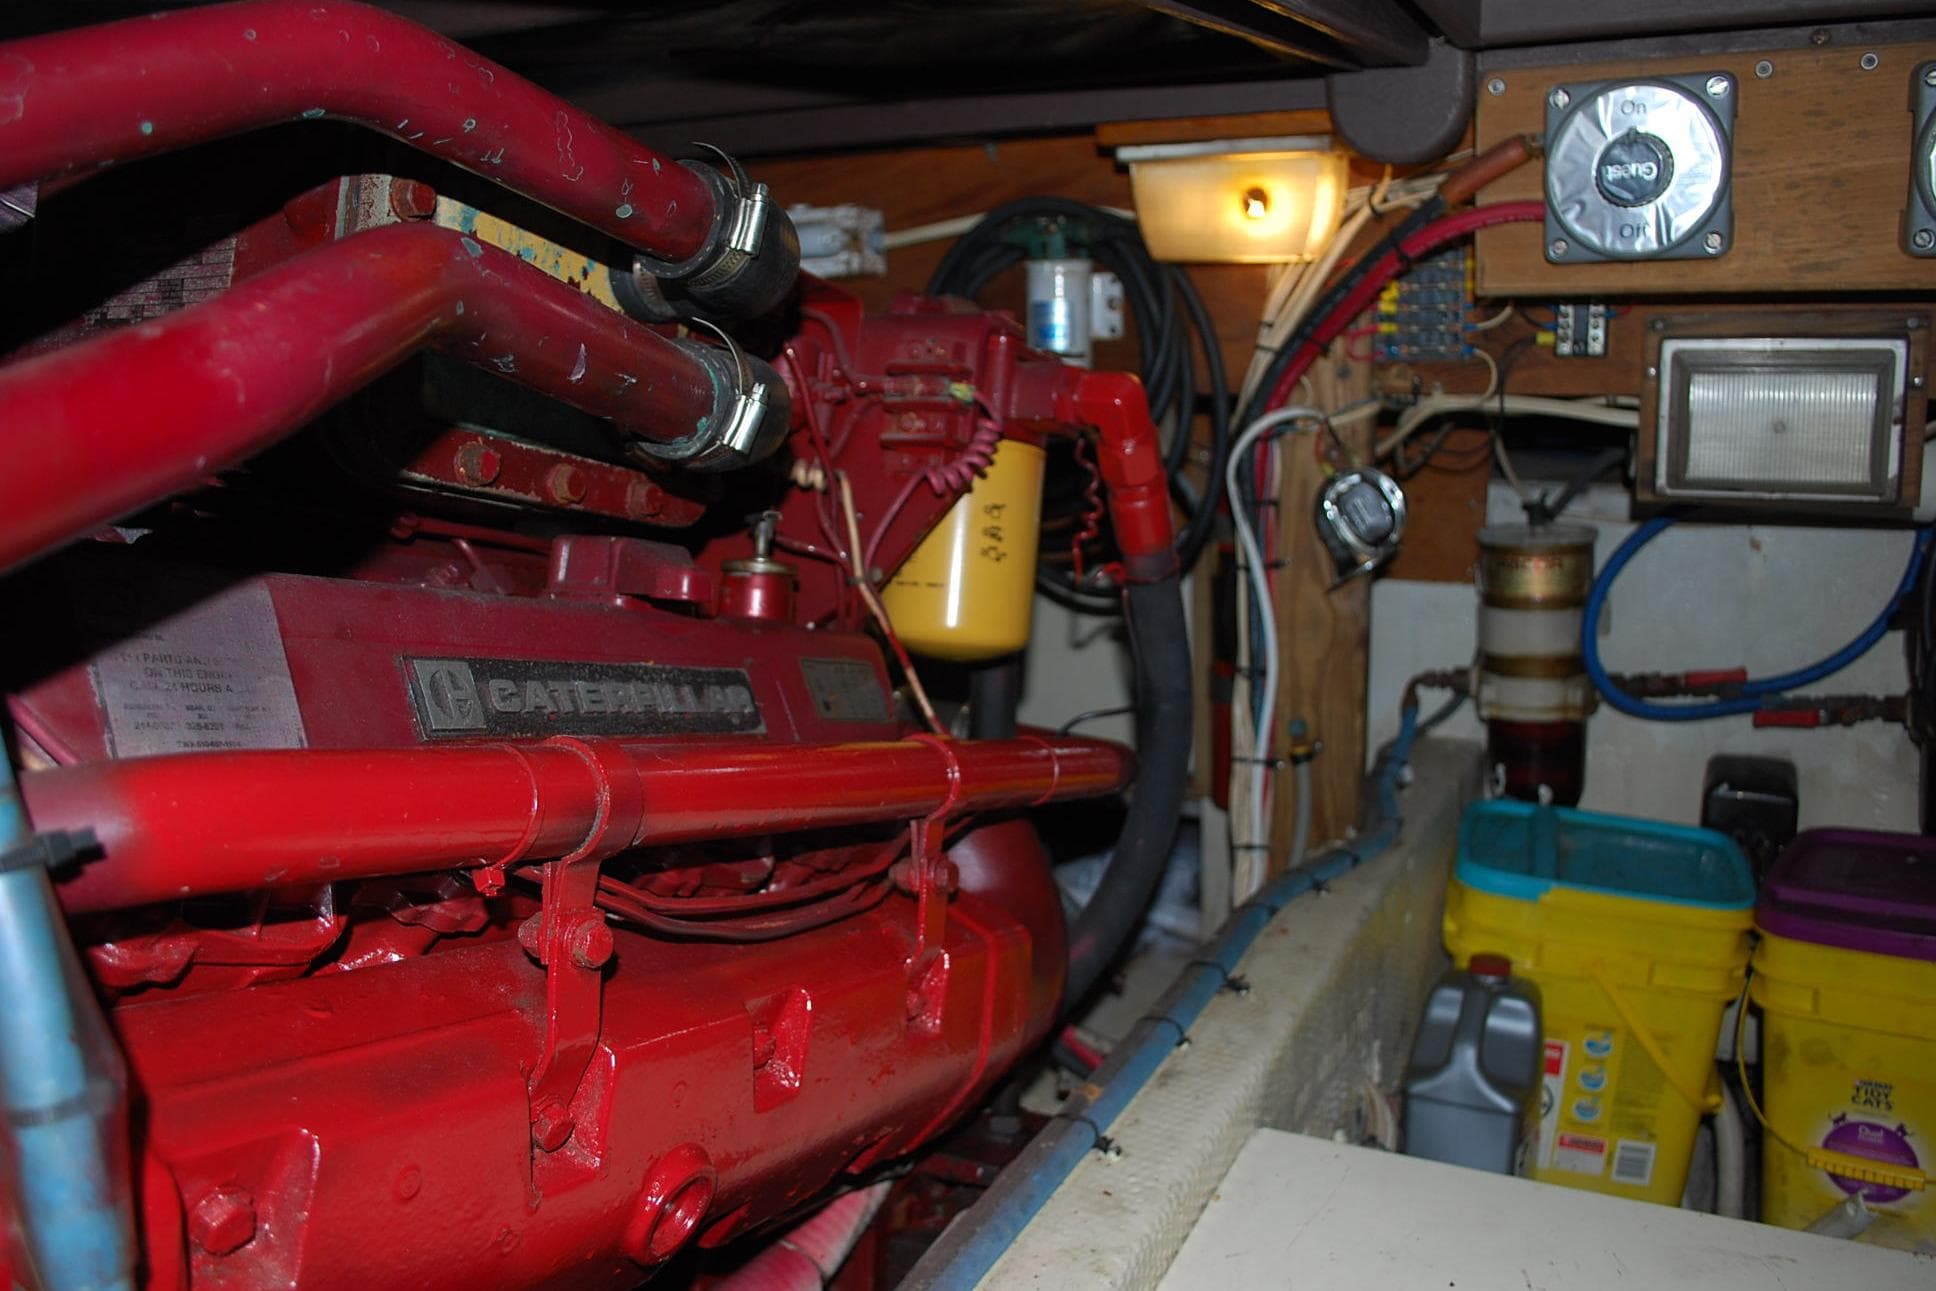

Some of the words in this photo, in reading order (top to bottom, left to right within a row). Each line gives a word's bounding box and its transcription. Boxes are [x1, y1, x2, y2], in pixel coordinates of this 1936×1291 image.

[1620, 99, 1648, 115] On
[1605, 161, 1659, 182] Guest
[488, 677, 754, 715] CATERPILLAR
